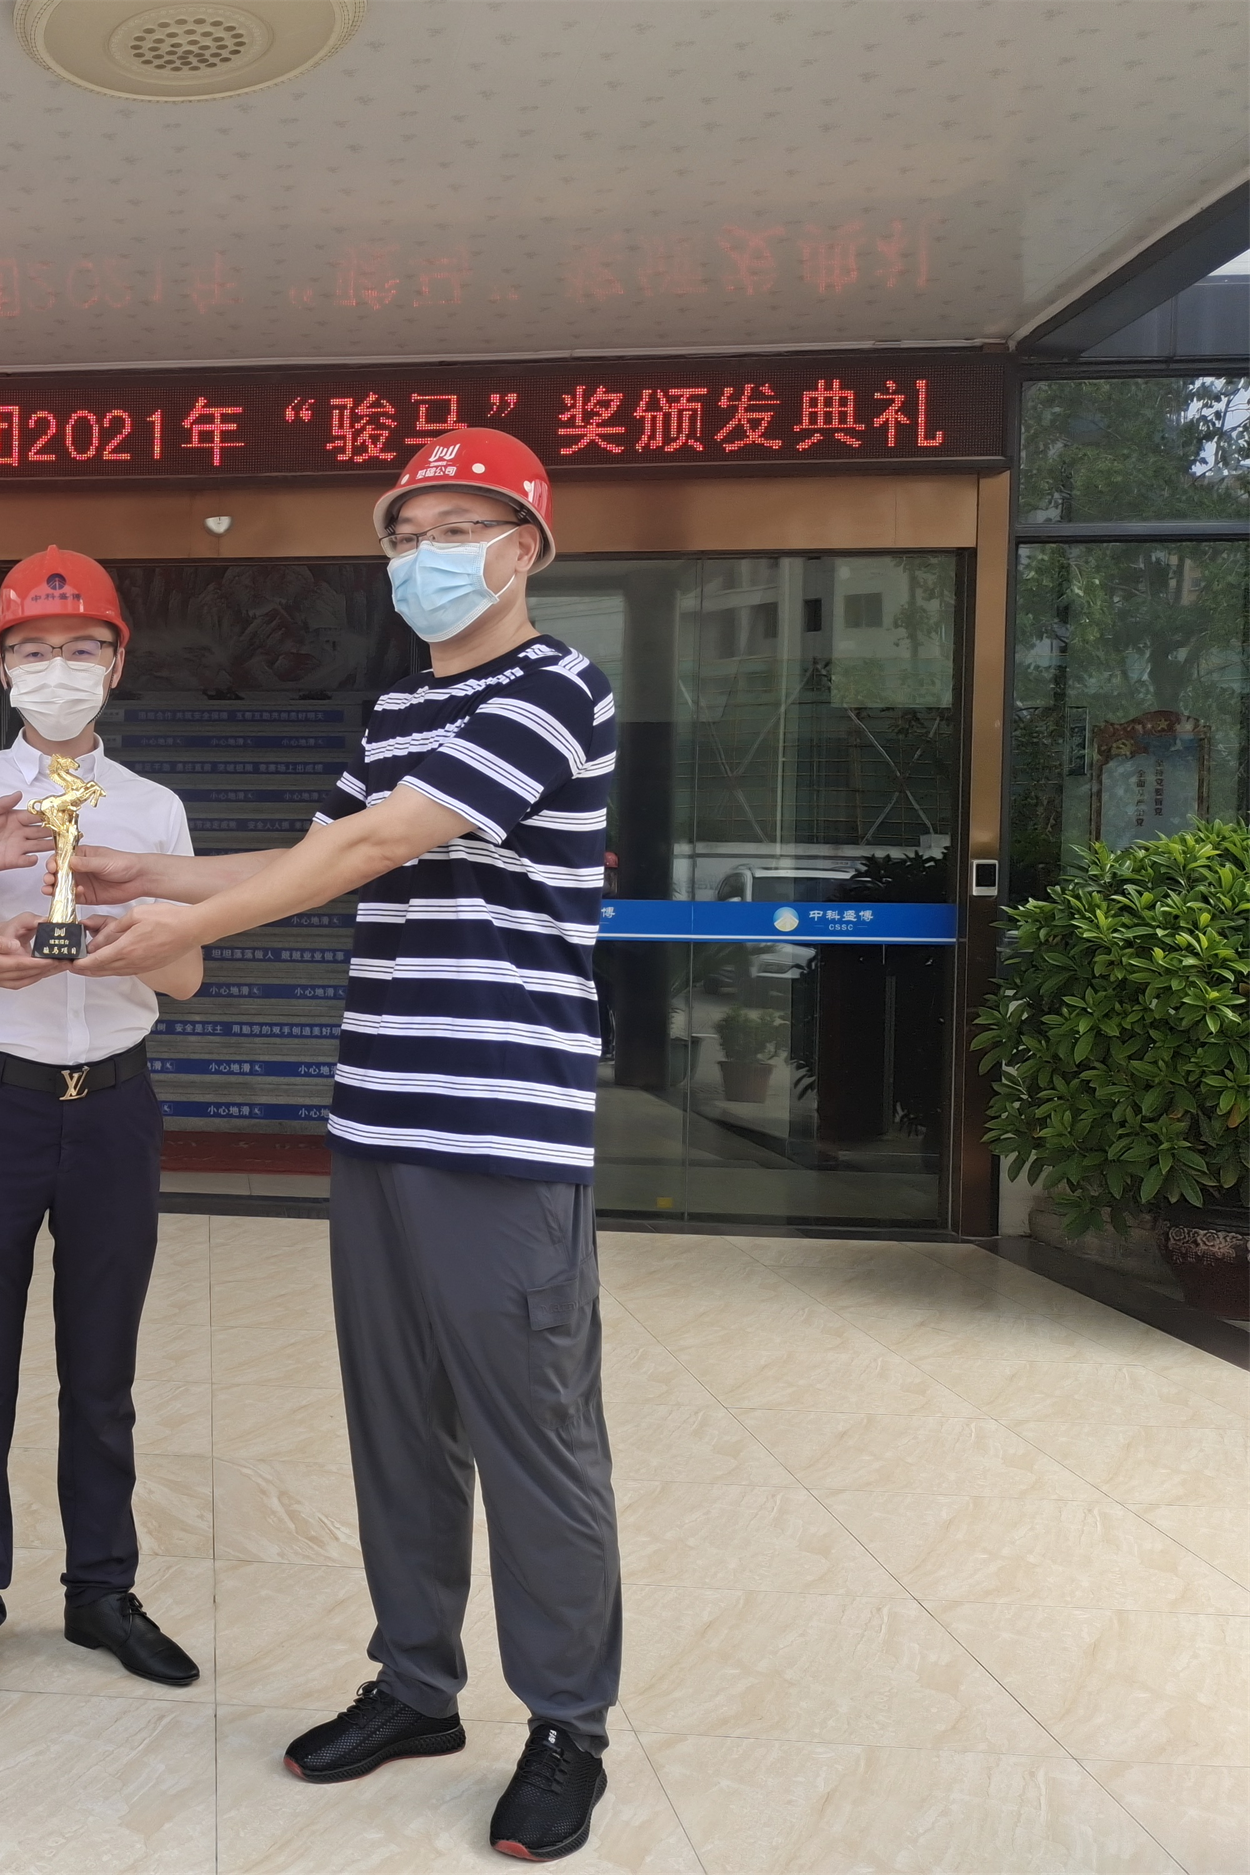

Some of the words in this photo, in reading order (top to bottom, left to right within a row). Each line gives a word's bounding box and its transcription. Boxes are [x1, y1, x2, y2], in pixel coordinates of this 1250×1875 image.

[31, 592, 84, 603] 中科盛博
[210, 791, 245, 800] 小心地滑
[283, 791, 319, 801] 小心地滑
[291, 916, 329, 925] 小心地滑
[808, 909, 874, 922] 中科盛博
[828, 923, 854, 931] CSSC
[209, 986, 249, 996] 小心地滑
[294, 987, 335, 997] 小心地滑
[174, 1023, 223, 1033] 安全是沃土
[208, 1063, 251, 1073] 小心地滑
[207, 1105, 250, 1116] 小心地滑
